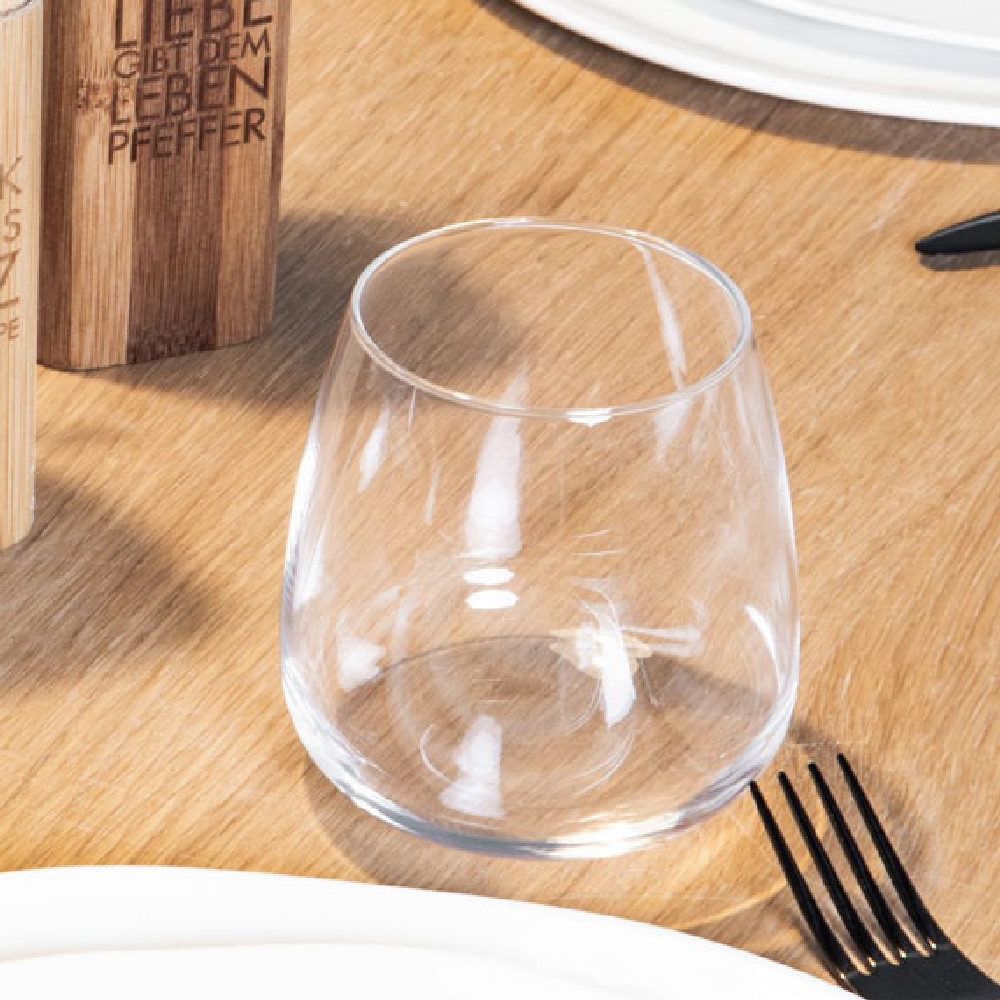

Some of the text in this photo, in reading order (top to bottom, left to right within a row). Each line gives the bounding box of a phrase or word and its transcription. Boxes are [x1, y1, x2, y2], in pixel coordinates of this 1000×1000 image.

[114, 28, 271, 79] GIBT DEM
[111, 56, 271, 127] LEBEN
[107, 107, 266, 165] PFEFFER
